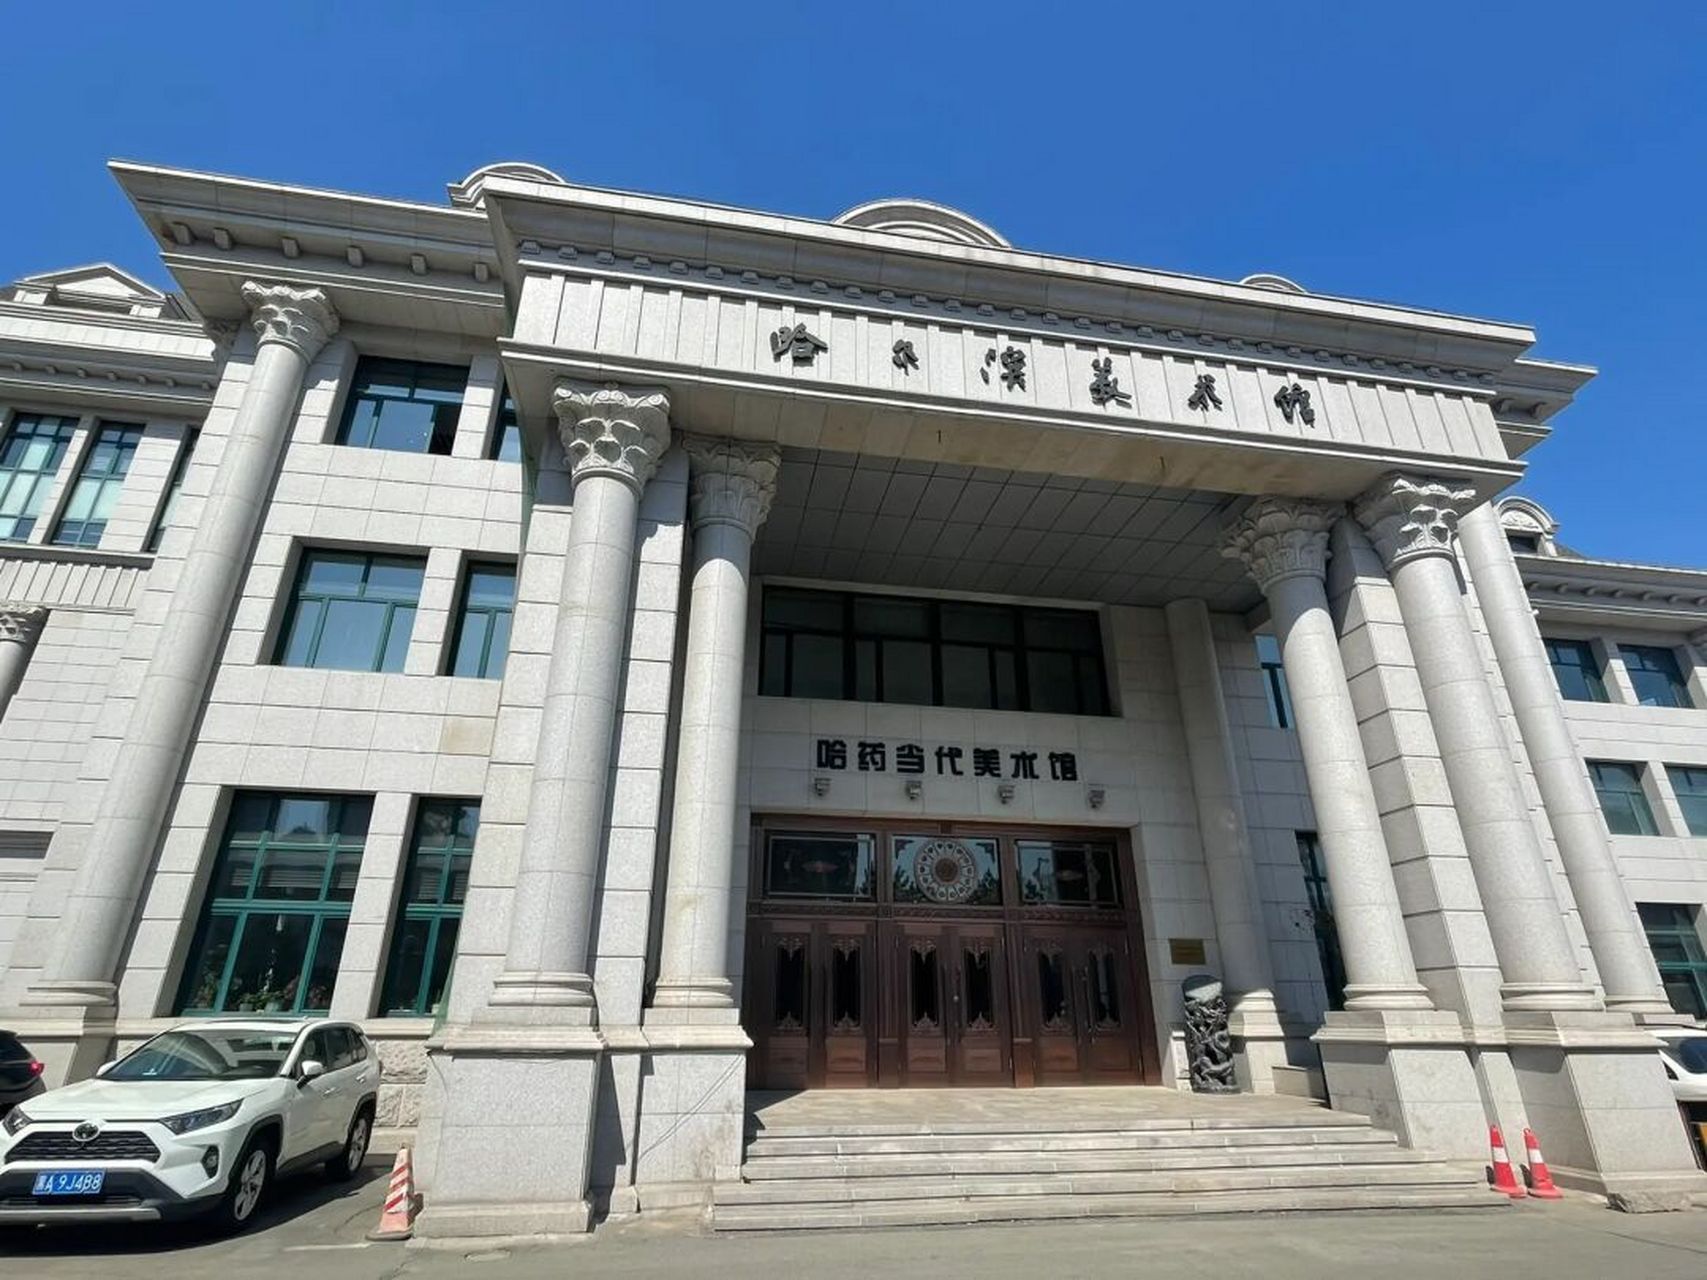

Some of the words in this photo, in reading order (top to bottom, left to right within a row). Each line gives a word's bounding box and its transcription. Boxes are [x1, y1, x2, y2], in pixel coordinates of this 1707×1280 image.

[816, 739, 1078, 781] 哈药当代美术馆
